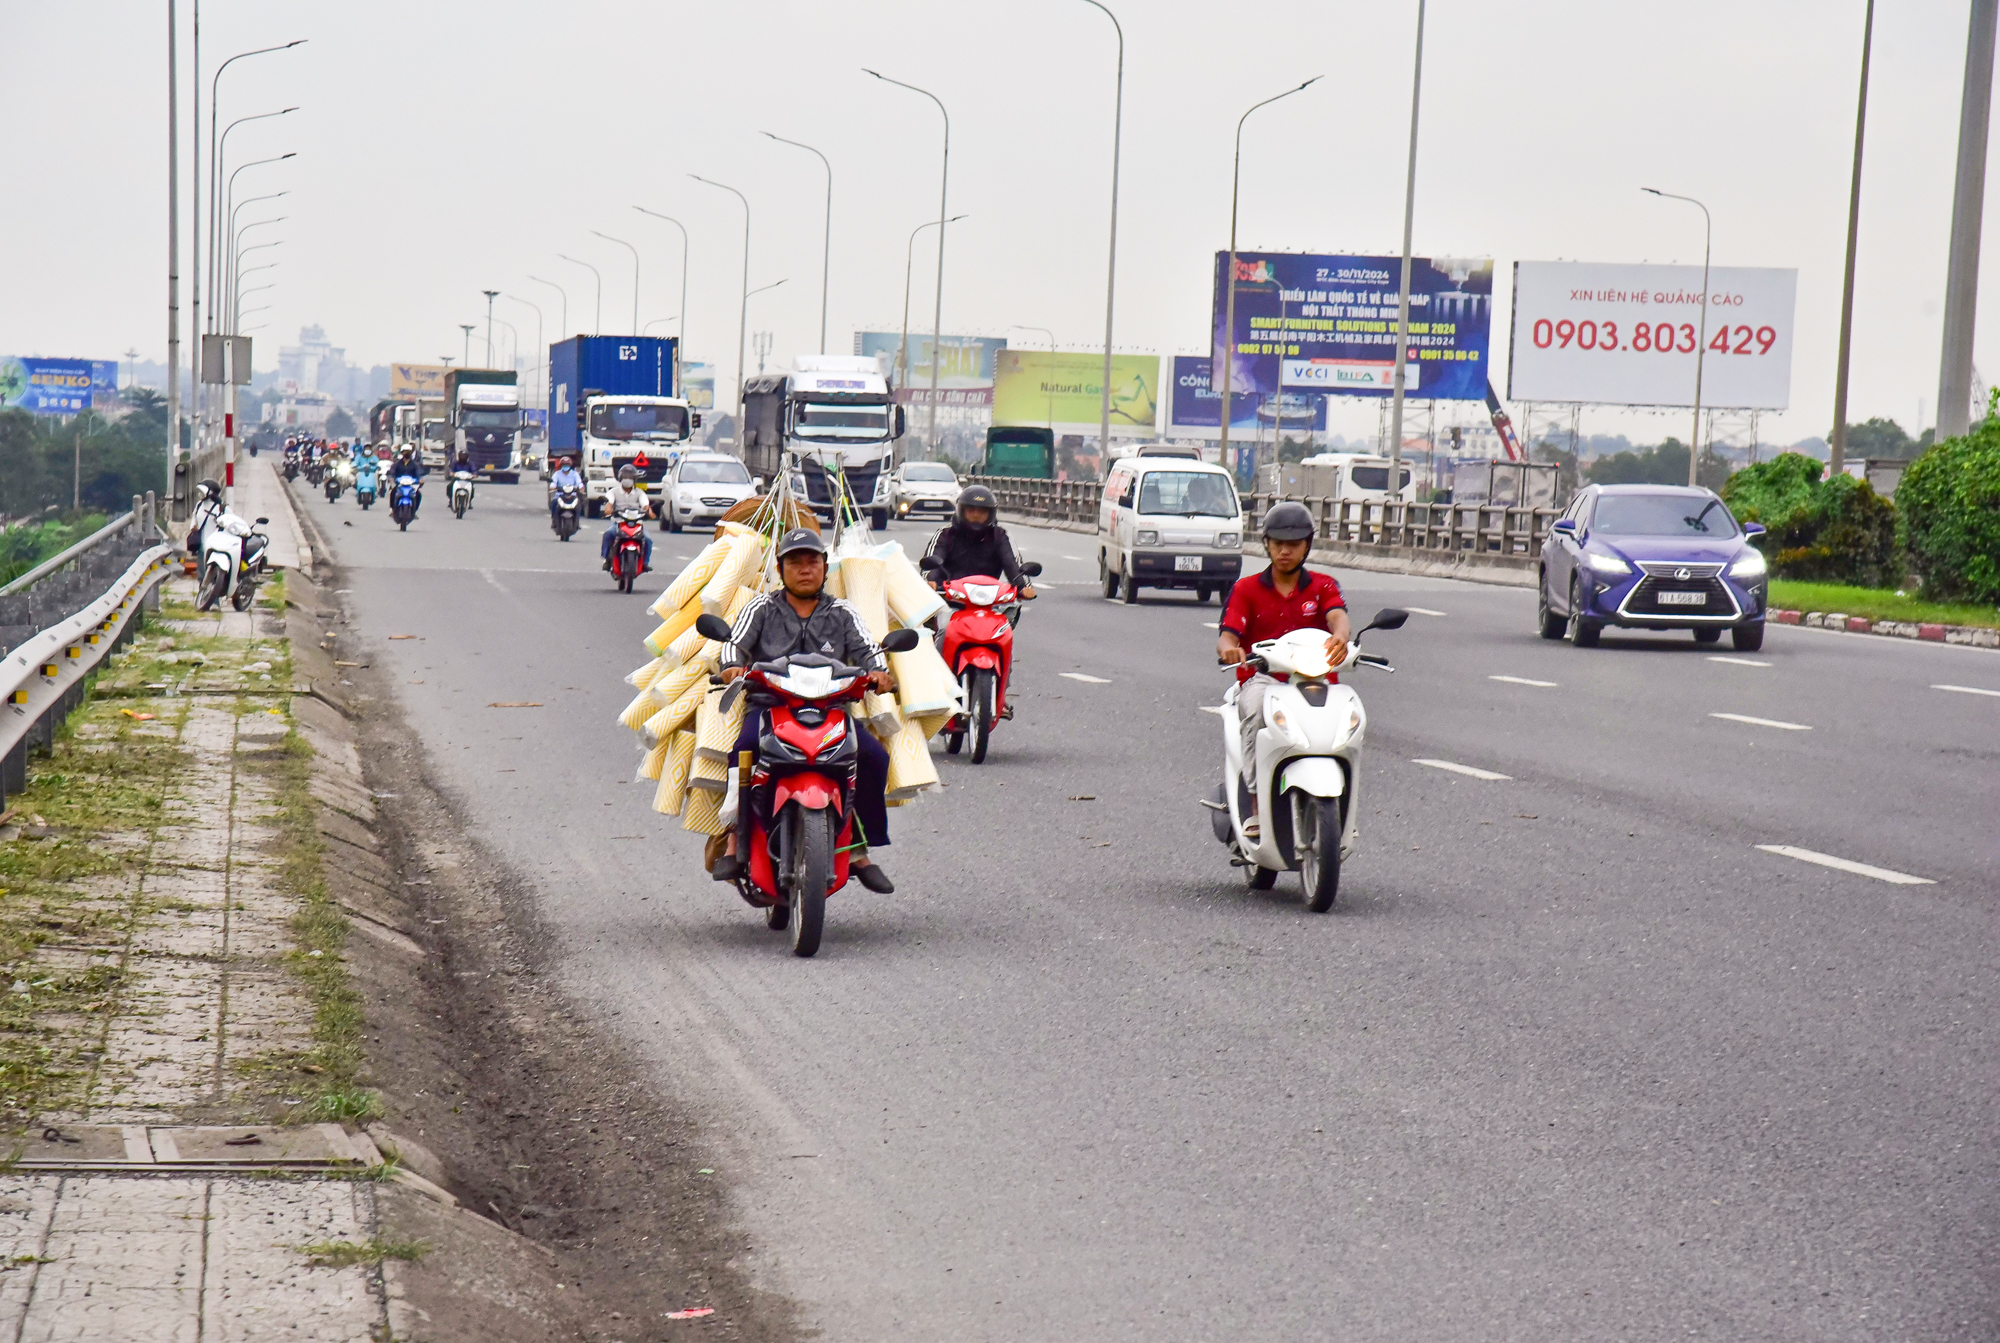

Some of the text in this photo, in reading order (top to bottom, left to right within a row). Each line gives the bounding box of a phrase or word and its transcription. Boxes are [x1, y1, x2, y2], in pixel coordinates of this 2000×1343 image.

[1316, 268, 1329, 277] 27
[1337, 268, 1390, 280] 30/11/2024
[1570, 290, 1593, 302] XIN
[1597, 288, 1626, 303] LIÊN
[1630, 289, 1648, 304] HỆ
[1654, 288, 1705, 305] QUẢNG
[1379, 307, 1400, 319] MIN
[1250, 317, 1456, 335] SMART FURNITURE SOLUTIONS VINAM 2024
[1533, 318, 1777, 356] 0903.803.429
[31, 374, 91, 388] SENKO
[1040, 382, 1082, 394] Natural
